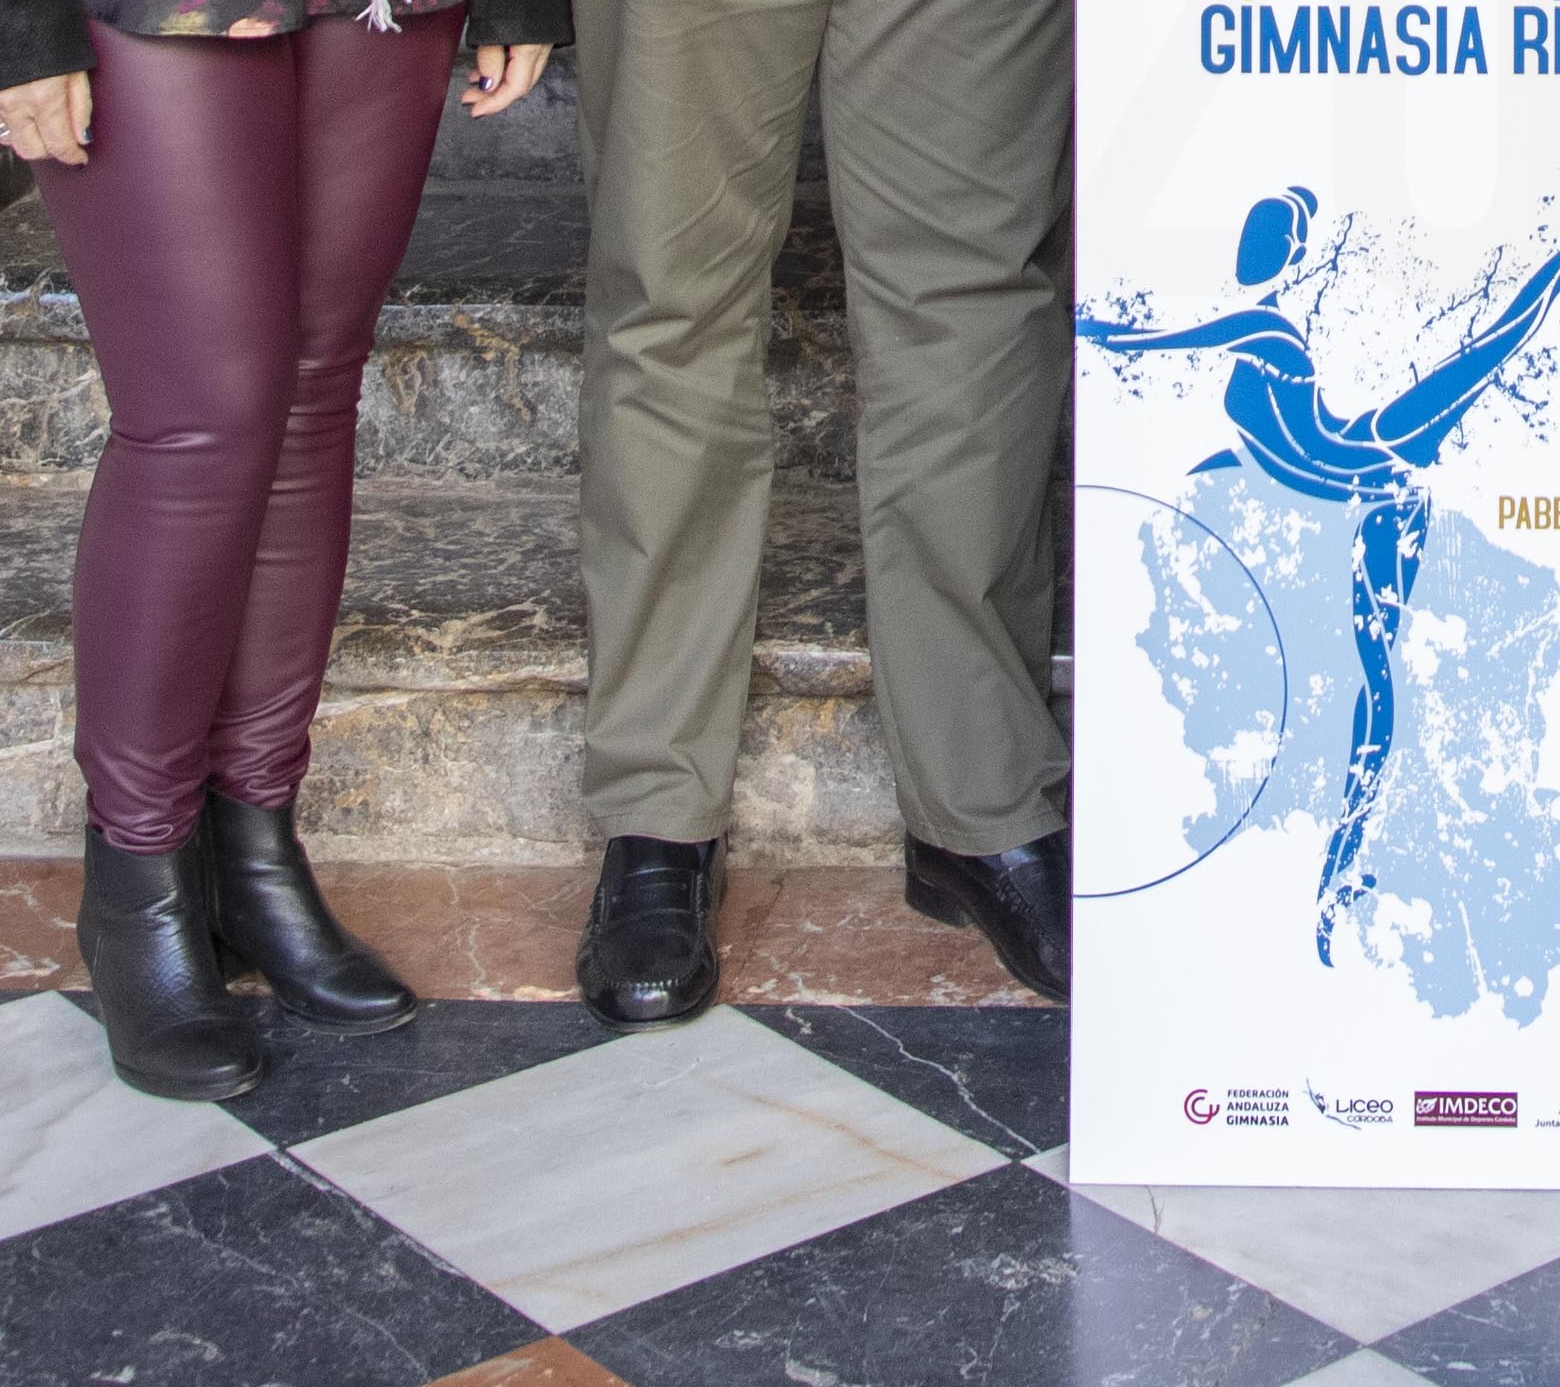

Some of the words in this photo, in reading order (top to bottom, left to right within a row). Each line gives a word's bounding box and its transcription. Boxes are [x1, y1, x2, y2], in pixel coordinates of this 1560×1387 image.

[1201, 4, 1488, 76] GIMNASIA
[1227, 1088, 1289, 1099] FEDERACIÓN
[1227, 1101, 1289, 1112] ANDALUZA
[1439, 1097, 1517, 1115] IMDECO
[1226, 1114, 1289, 1127] GIMNASIA
[1535, 1119, 1560, 1128] Junta
